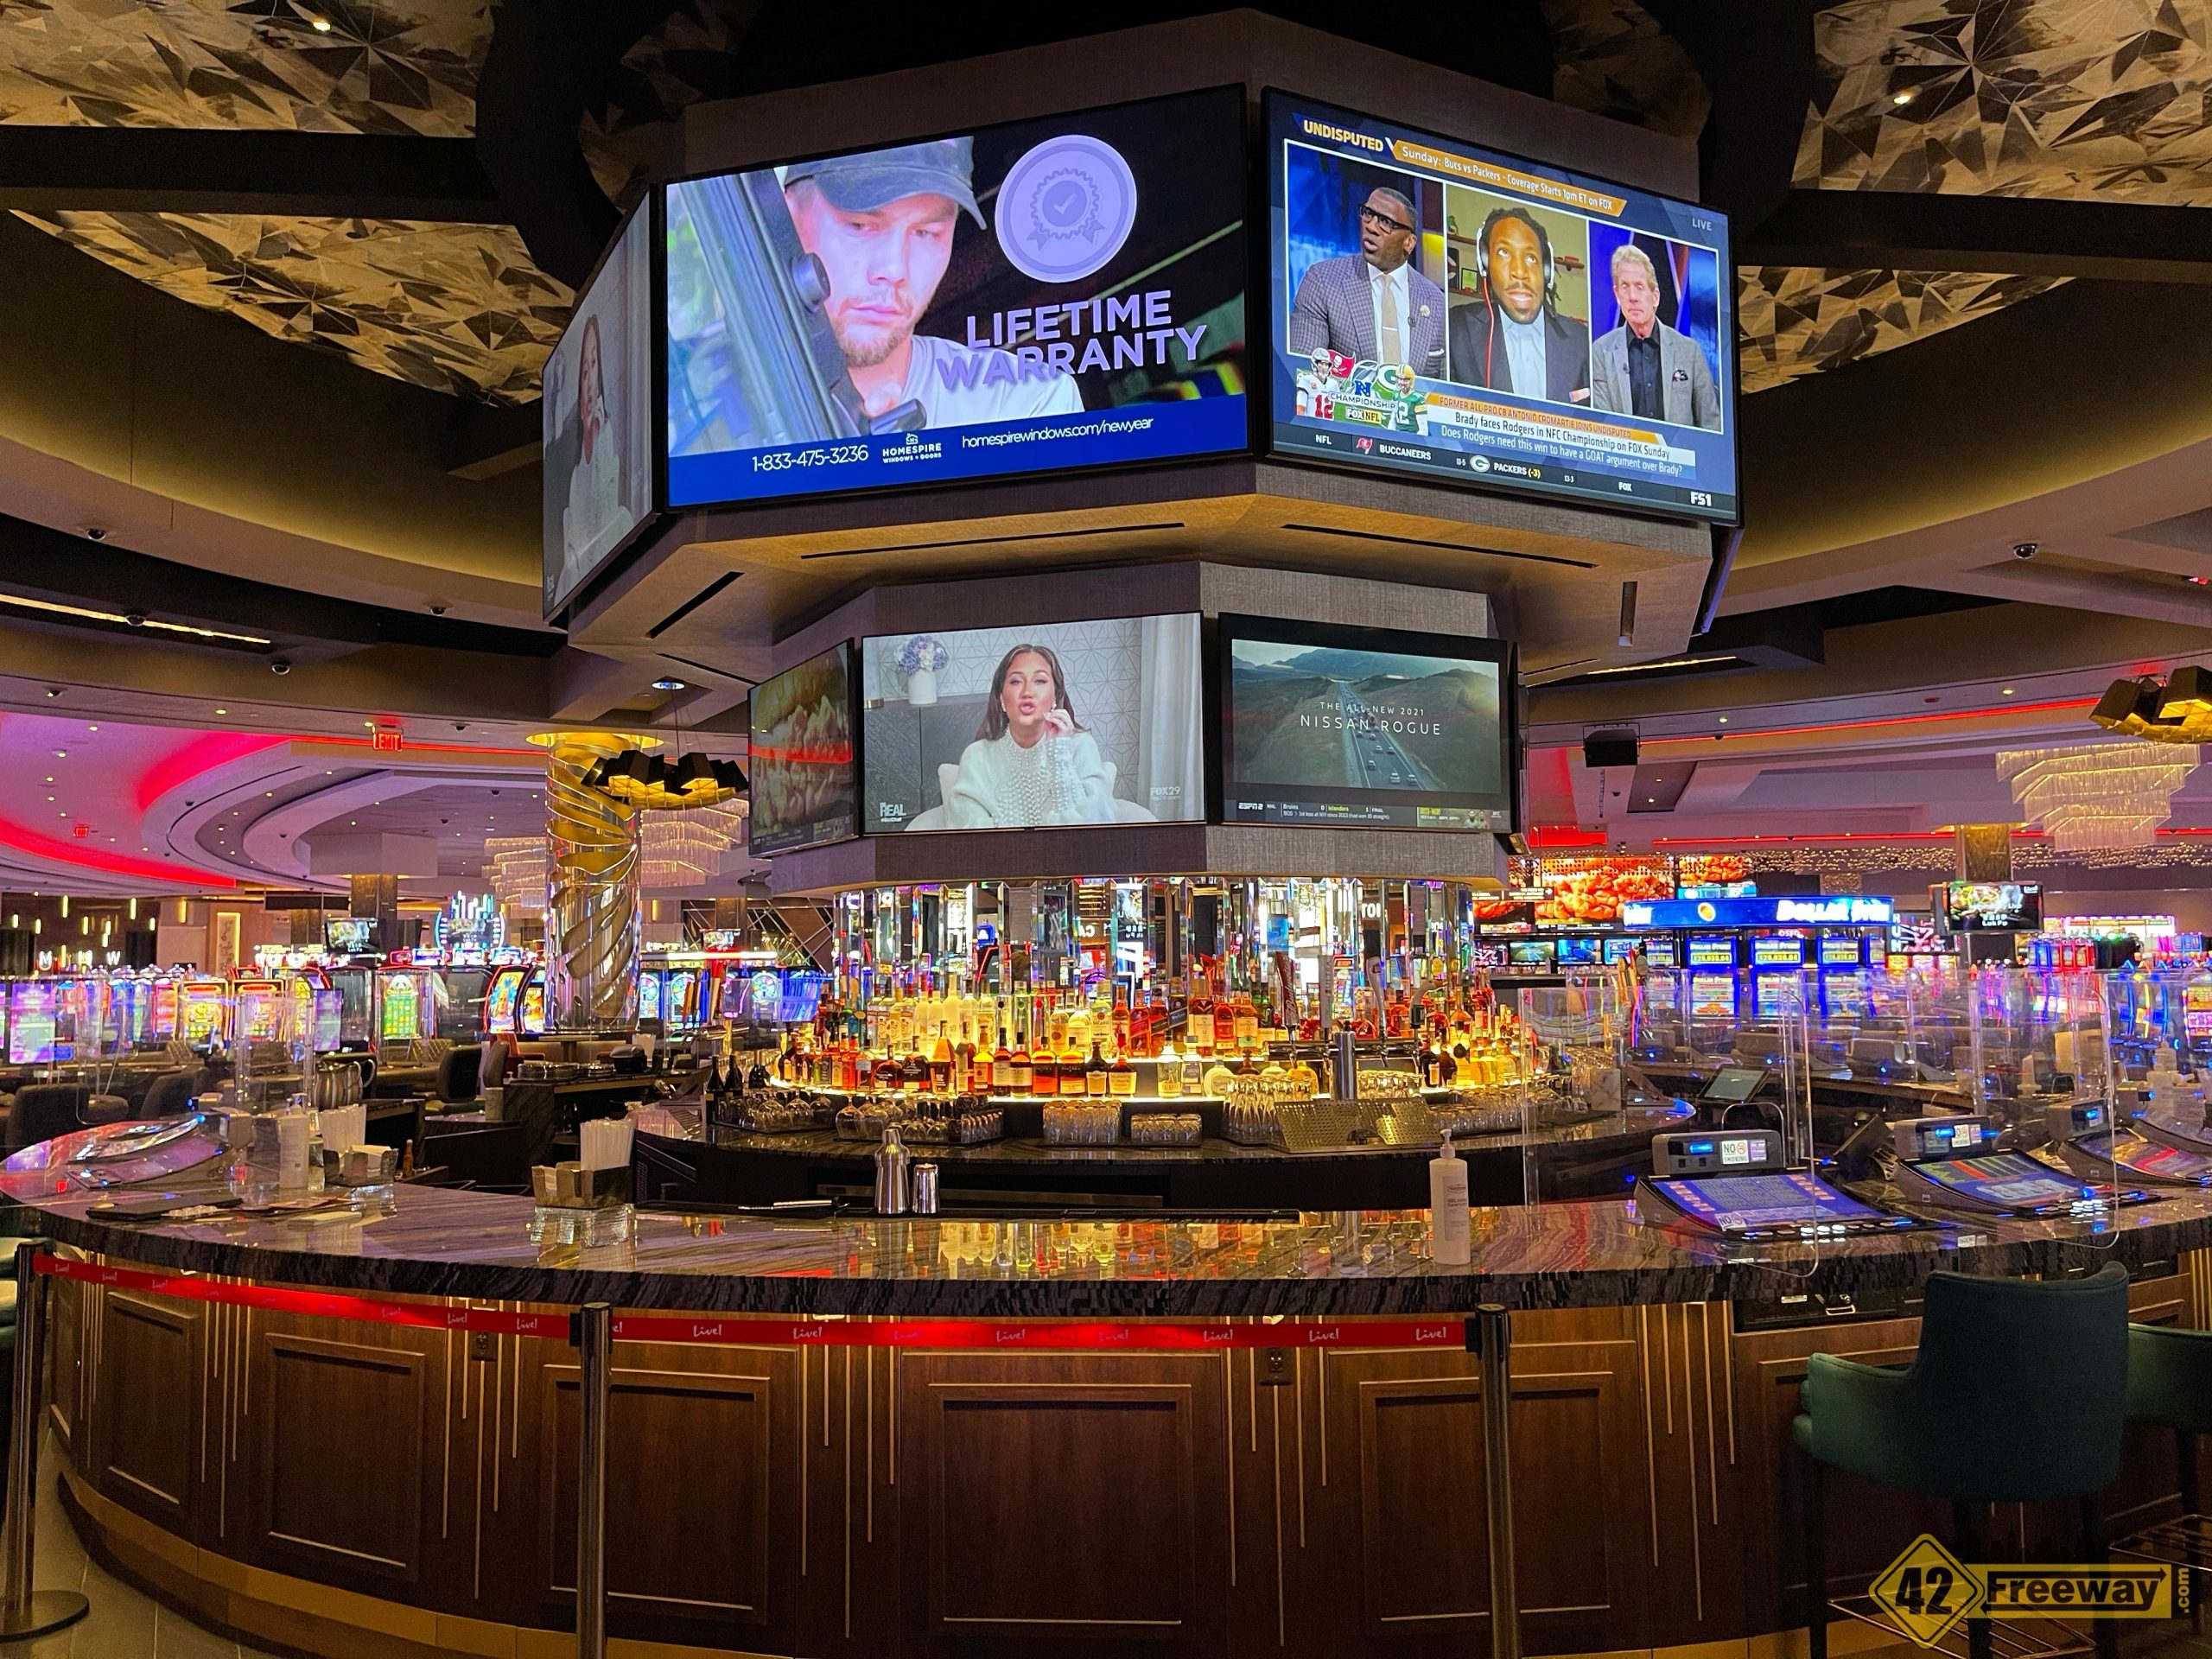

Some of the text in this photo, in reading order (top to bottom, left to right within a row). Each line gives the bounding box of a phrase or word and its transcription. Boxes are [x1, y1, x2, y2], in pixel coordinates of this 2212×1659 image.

[1303, 119, 1384, 152] UNDISPUTED
[1402, 146, 1613, 211] Sunday: Bucs vs Packers Coverage Starts 1pm ET on FOX
[1692, 218, 1713, 232] LIVE
[966, 289, 1172, 348] LIFETIME
[935, 324, 1208, 390] WARRANTY
[1329, 391, 1397, 410] CHAMPIONSHIP
[1347, 408, 1381, 422] FOX NFL
[1440, 397, 1631, 438] FORMER ALL-PRO CB ANTONIO CROMARTIE JOINS UNDISPUTED
[962, 416, 1154, 448] homespirewindows.com/newyear
[1315, 434, 1332, 445] NFL
[1455, 412, 1670, 461] Brady faces Rodgers in NFC Championship on FOX Sunday
[882, 442, 942, 457] HOMESPIRE
[1380, 444, 1432, 460] BUCCANEERS
[1441, 425, 1461, 439] Does
[1464, 429, 1496, 446] Rodgers
[1497, 435, 1516, 448] need
[1517, 438, 1533, 450] this
[1534, 442, 1548, 454] win
[1549, 445, 1558, 454] to
[1560, 447, 1578, 459] have
[1586, 450, 1604, 462] GOAT
[1606, 454, 1641, 468] argument
[1643, 461, 1657, 471] over
[1658, 465, 1683, 477] Brady?
[752, 444, 869, 472] 1-833-475-3236
[882, 452, 942, 464] WINDOWS DOORS
[1494, 462, 1541, 480] PACKERS (-3)
[1618, 481, 1632, 493] FOX
[1690, 491, 1713, 507] FS1
[1320, 702, 1425, 716] THE ALL-NEW 2021
[1300, 715, 1440, 735] NISSAN ROGUE
[378, 733, 400, 751] EXIT
[1150, 785, 1181, 796] FOX29
[880, 802, 906, 817] REAL
[1723, 1143, 1736, 1153] NO
[1719, 1216, 1732, 1224] NO
[447, 1313, 467, 1325] Live!
[517, 1318, 537, 1329] Live!
[693, 1324, 722, 1338] Live!
[792, 1325, 823, 1340] Live!
[996, 1329, 1026, 1342] Live!
[1202, 1329, 1234, 1342] Live!
[1308, 1327, 1339, 1343] Live!
[1415, 1326, 1446, 1341] Live!
